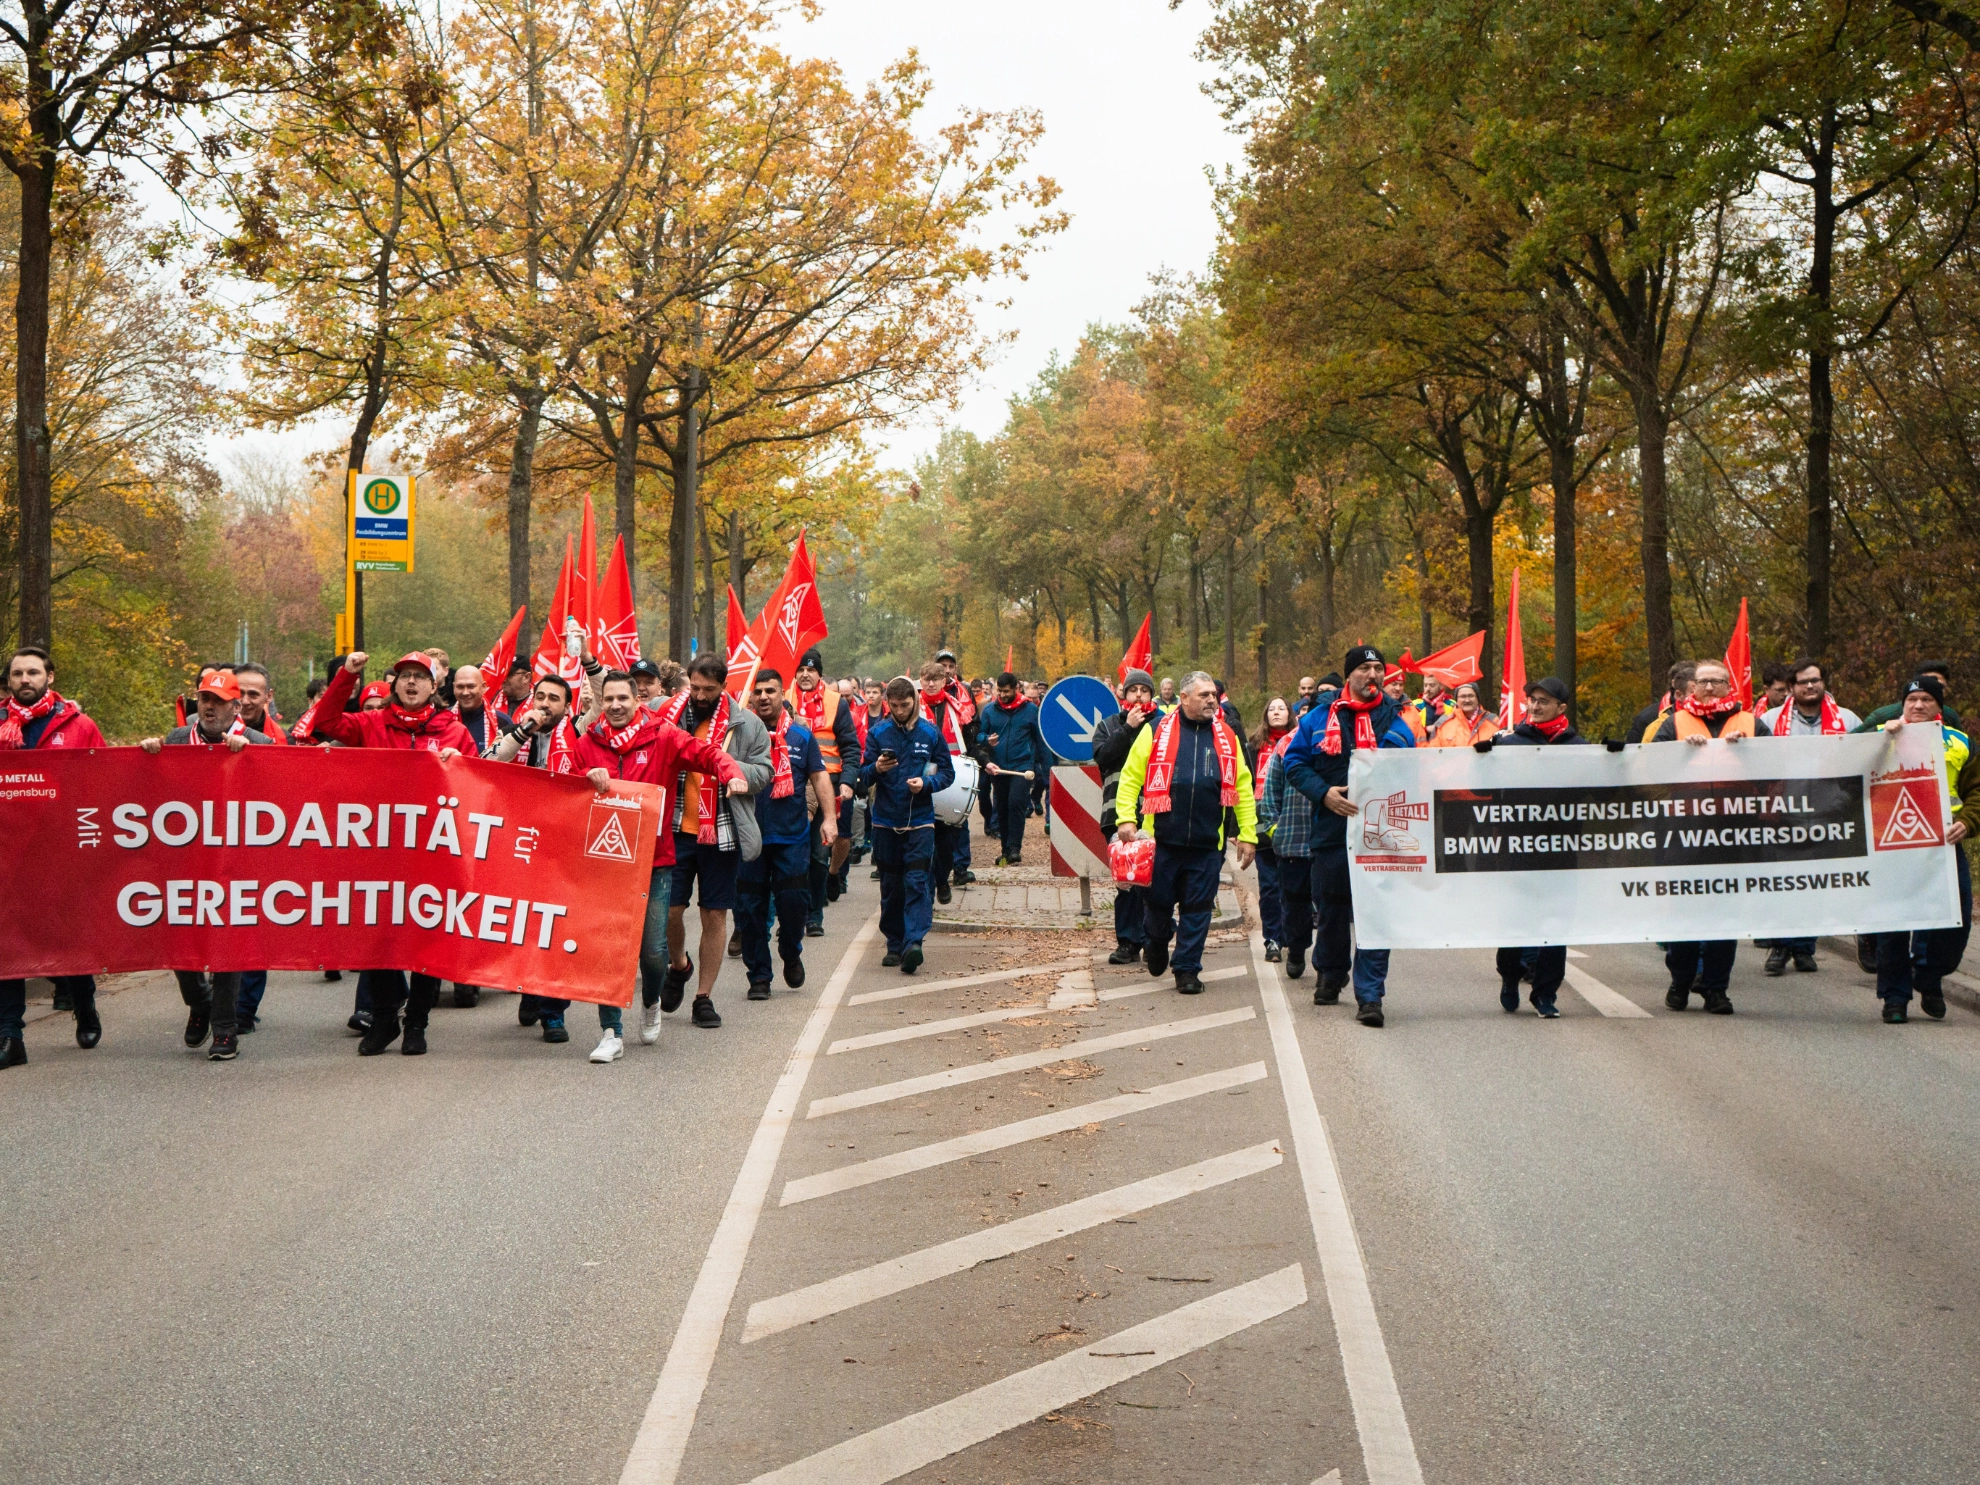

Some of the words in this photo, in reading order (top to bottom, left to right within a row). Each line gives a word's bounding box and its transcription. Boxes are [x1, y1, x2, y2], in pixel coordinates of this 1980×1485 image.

[357, 562, 375, 570] RVV
[5, 774, 45, 783] METALL
[0, 788, 56, 799] egensburg
[1394, 804, 1428, 819] METALL
[1473, 799, 1685, 823] VERTRAUENSLEUTE
[1692, 798, 1716, 817] IG
[1723, 795, 1815, 816] METALL
[77, 808, 101, 848] Mit
[112, 795, 503, 859] SOLIDARITÄT
[1444, 836, 1501, 855] BMW
[1508, 831, 1657, 853] REGENSBURG
[1680, 821, 1855, 847] WACKERSDORF
[514, 826, 540, 863] für
[1621, 881, 1649, 897] VK
[1655, 877, 1739, 896] BEREICH
[1746, 871, 1870, 892] PRESSWERK
[117, 880, 577, 952] GERECHTIGKEIT.
